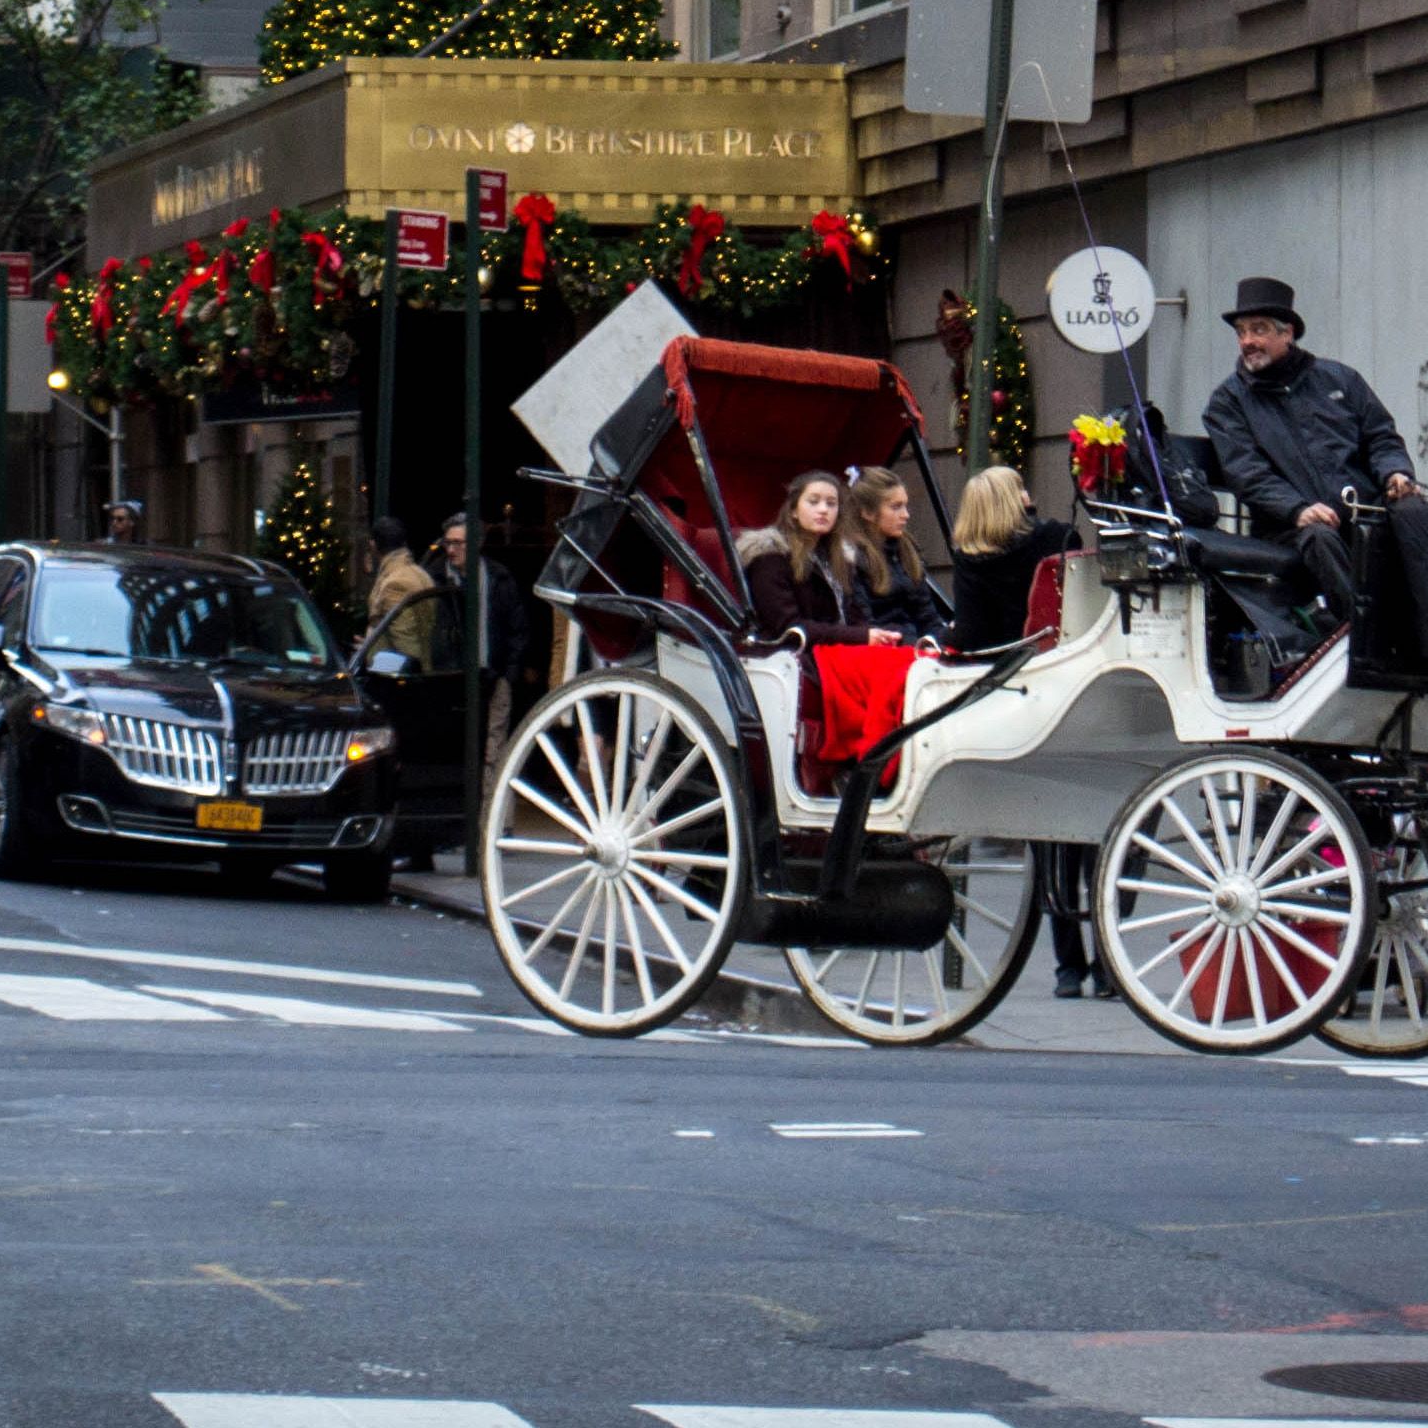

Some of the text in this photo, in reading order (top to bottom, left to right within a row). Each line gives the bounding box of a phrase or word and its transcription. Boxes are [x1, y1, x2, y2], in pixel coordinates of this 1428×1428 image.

[408, 123, 822, 158] OMNI BERKSHIRE PLACE
[1066, 307, 1140, 327] LLADRÓ
